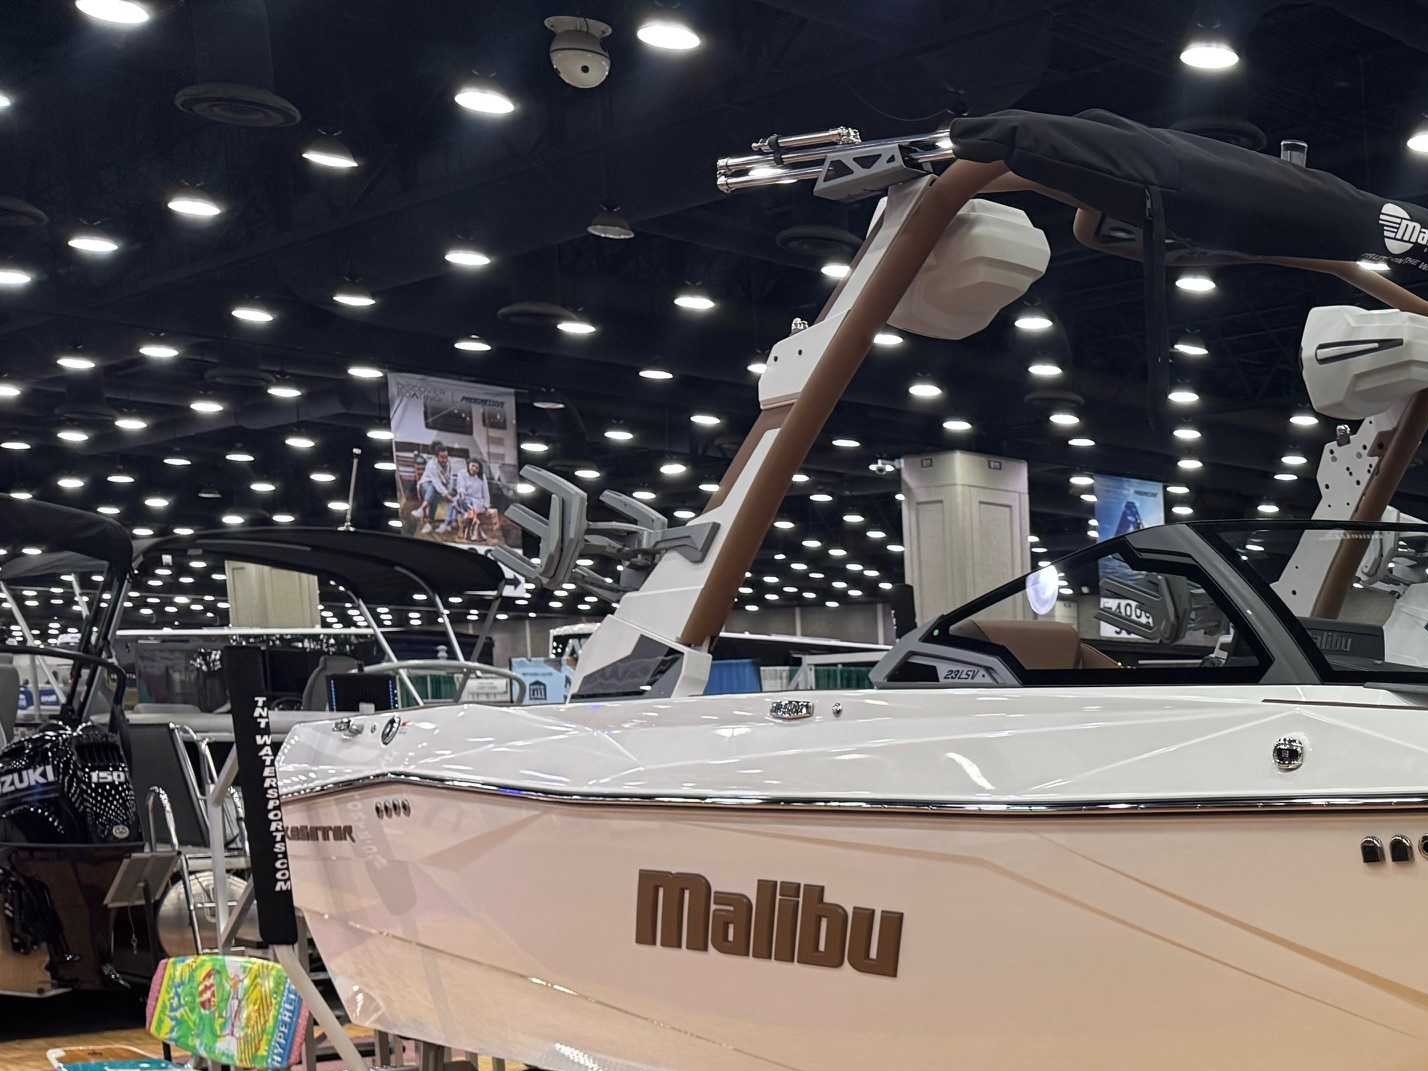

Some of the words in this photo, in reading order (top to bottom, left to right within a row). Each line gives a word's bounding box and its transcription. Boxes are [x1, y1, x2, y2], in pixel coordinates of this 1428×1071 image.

[1312, 630, 1352, 652] alibu
[253, 696, 269, 728] TNT
[0, 765, 55, 793] ZUKI
[255, 734, 291, 891] WATERSPORTS.COM
[635, 868, 904, 978] Malibu
